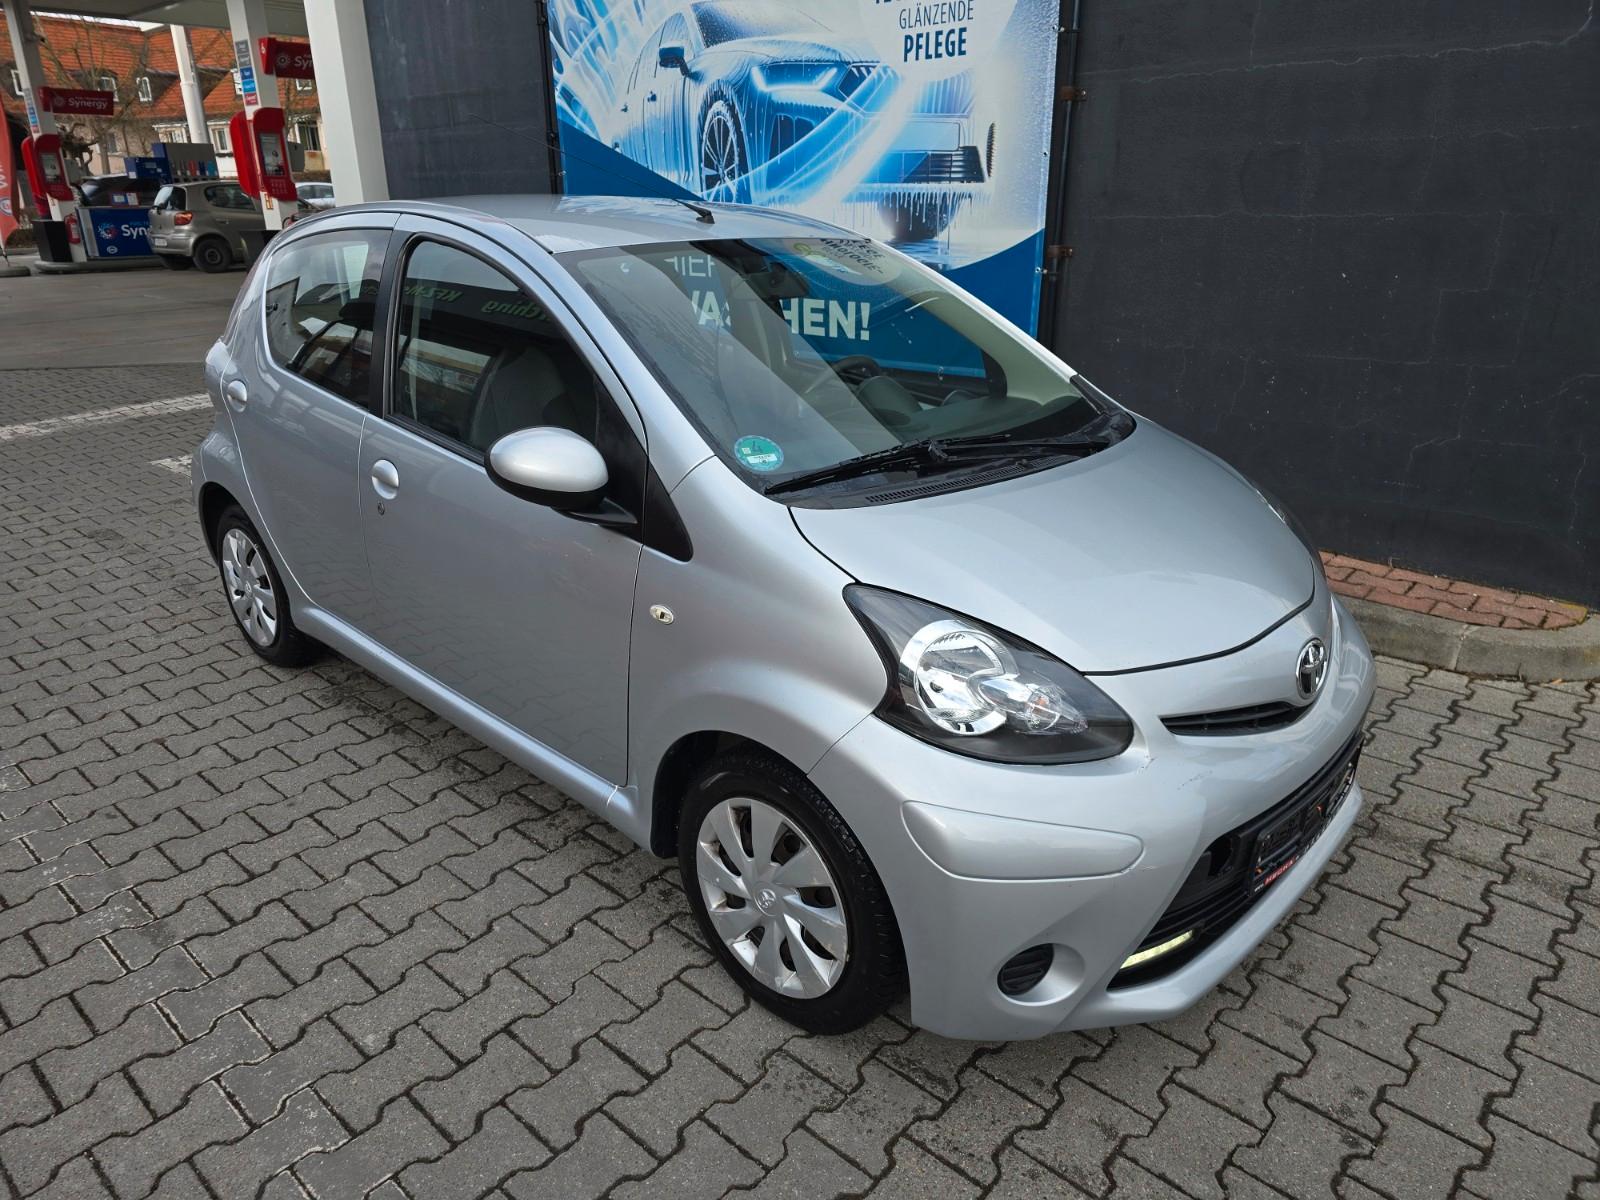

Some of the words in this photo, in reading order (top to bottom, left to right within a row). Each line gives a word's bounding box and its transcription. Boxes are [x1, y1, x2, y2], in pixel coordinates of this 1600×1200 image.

[899, 0, 974, 29] GLÄNZENDE
[903, 27, 967, 62] PFLEGE
[68, 97, 108, 109] Synergy
